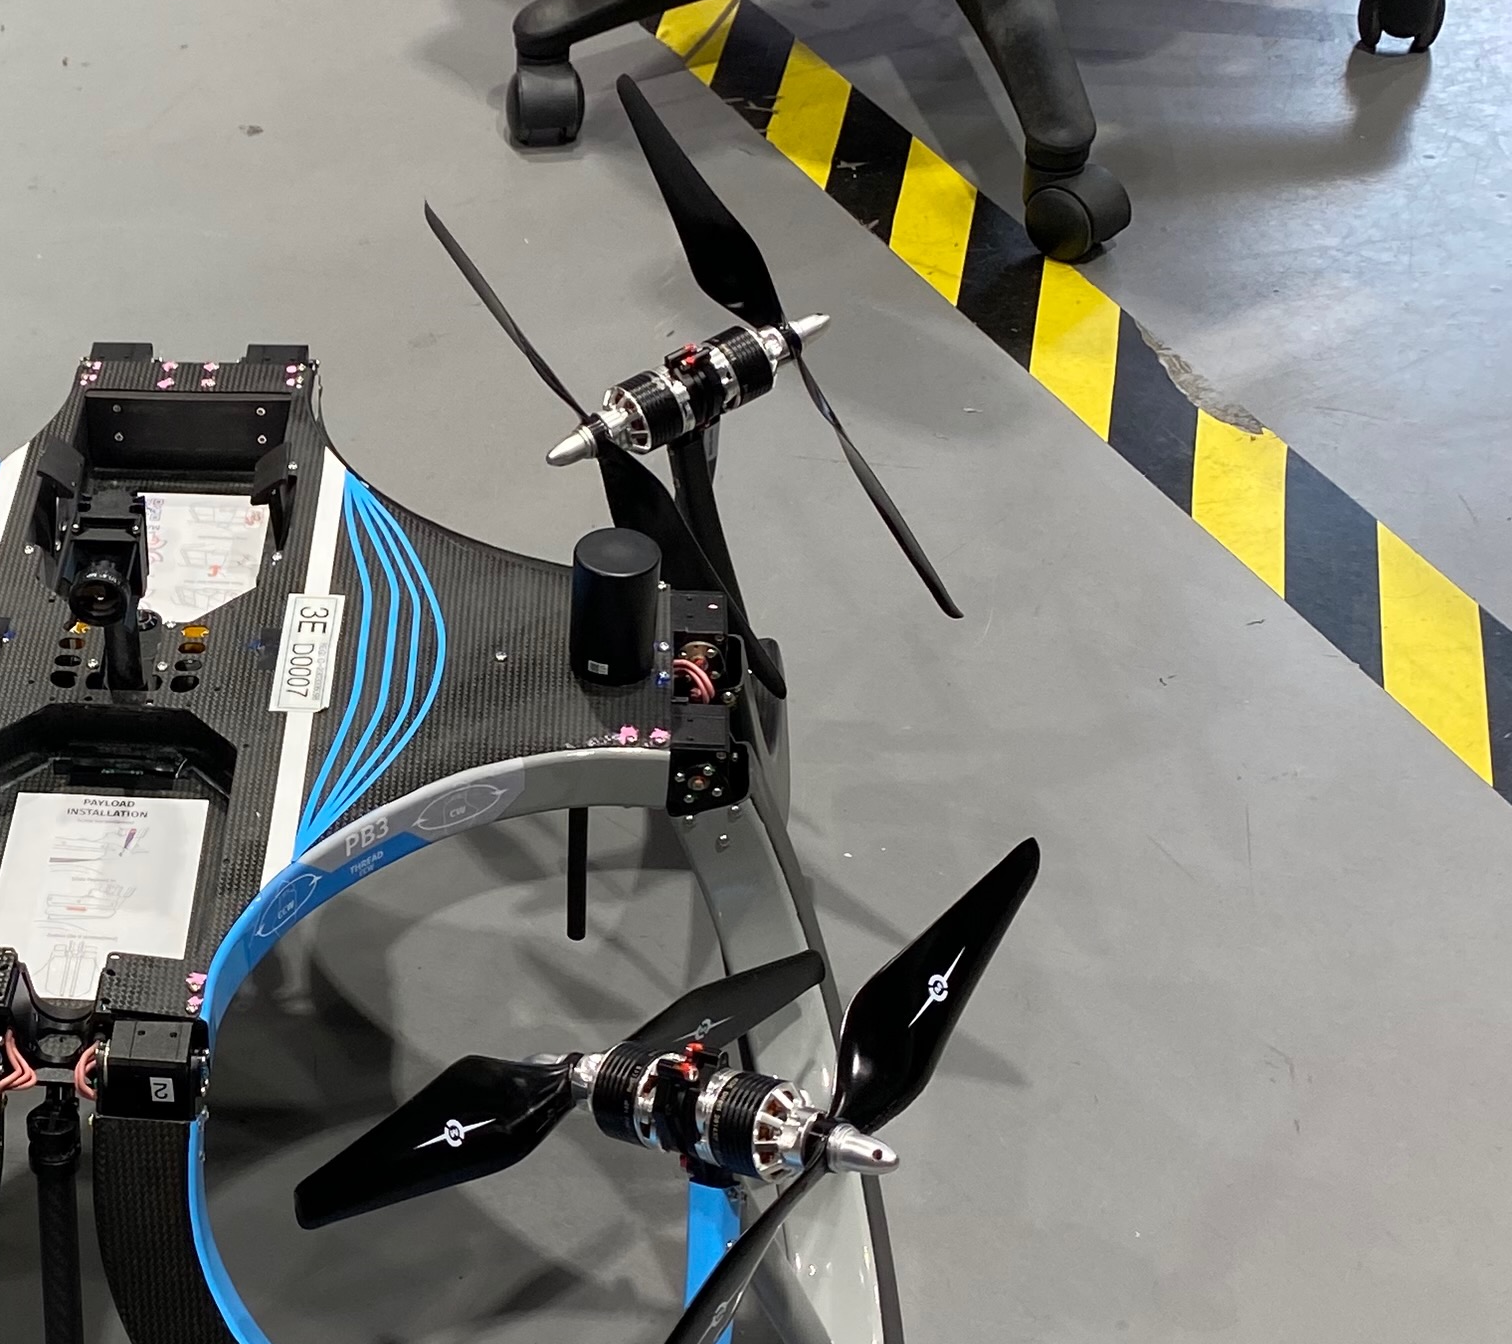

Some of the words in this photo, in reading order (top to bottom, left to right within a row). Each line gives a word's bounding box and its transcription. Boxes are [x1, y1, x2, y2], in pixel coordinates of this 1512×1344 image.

[297, 606, 329, 634] 3E
[286, 643, 315, 698] D0007
[67, 807, 148, 818] INSTALLATION
[83, 798, 136, 808] PAYLOAD
[449, 805, 466, 818] CW
[345, 816, 389, 857] PB3
[350, 850, 384, 875] THREAD
[153, 1082, 168, 1099] 2
